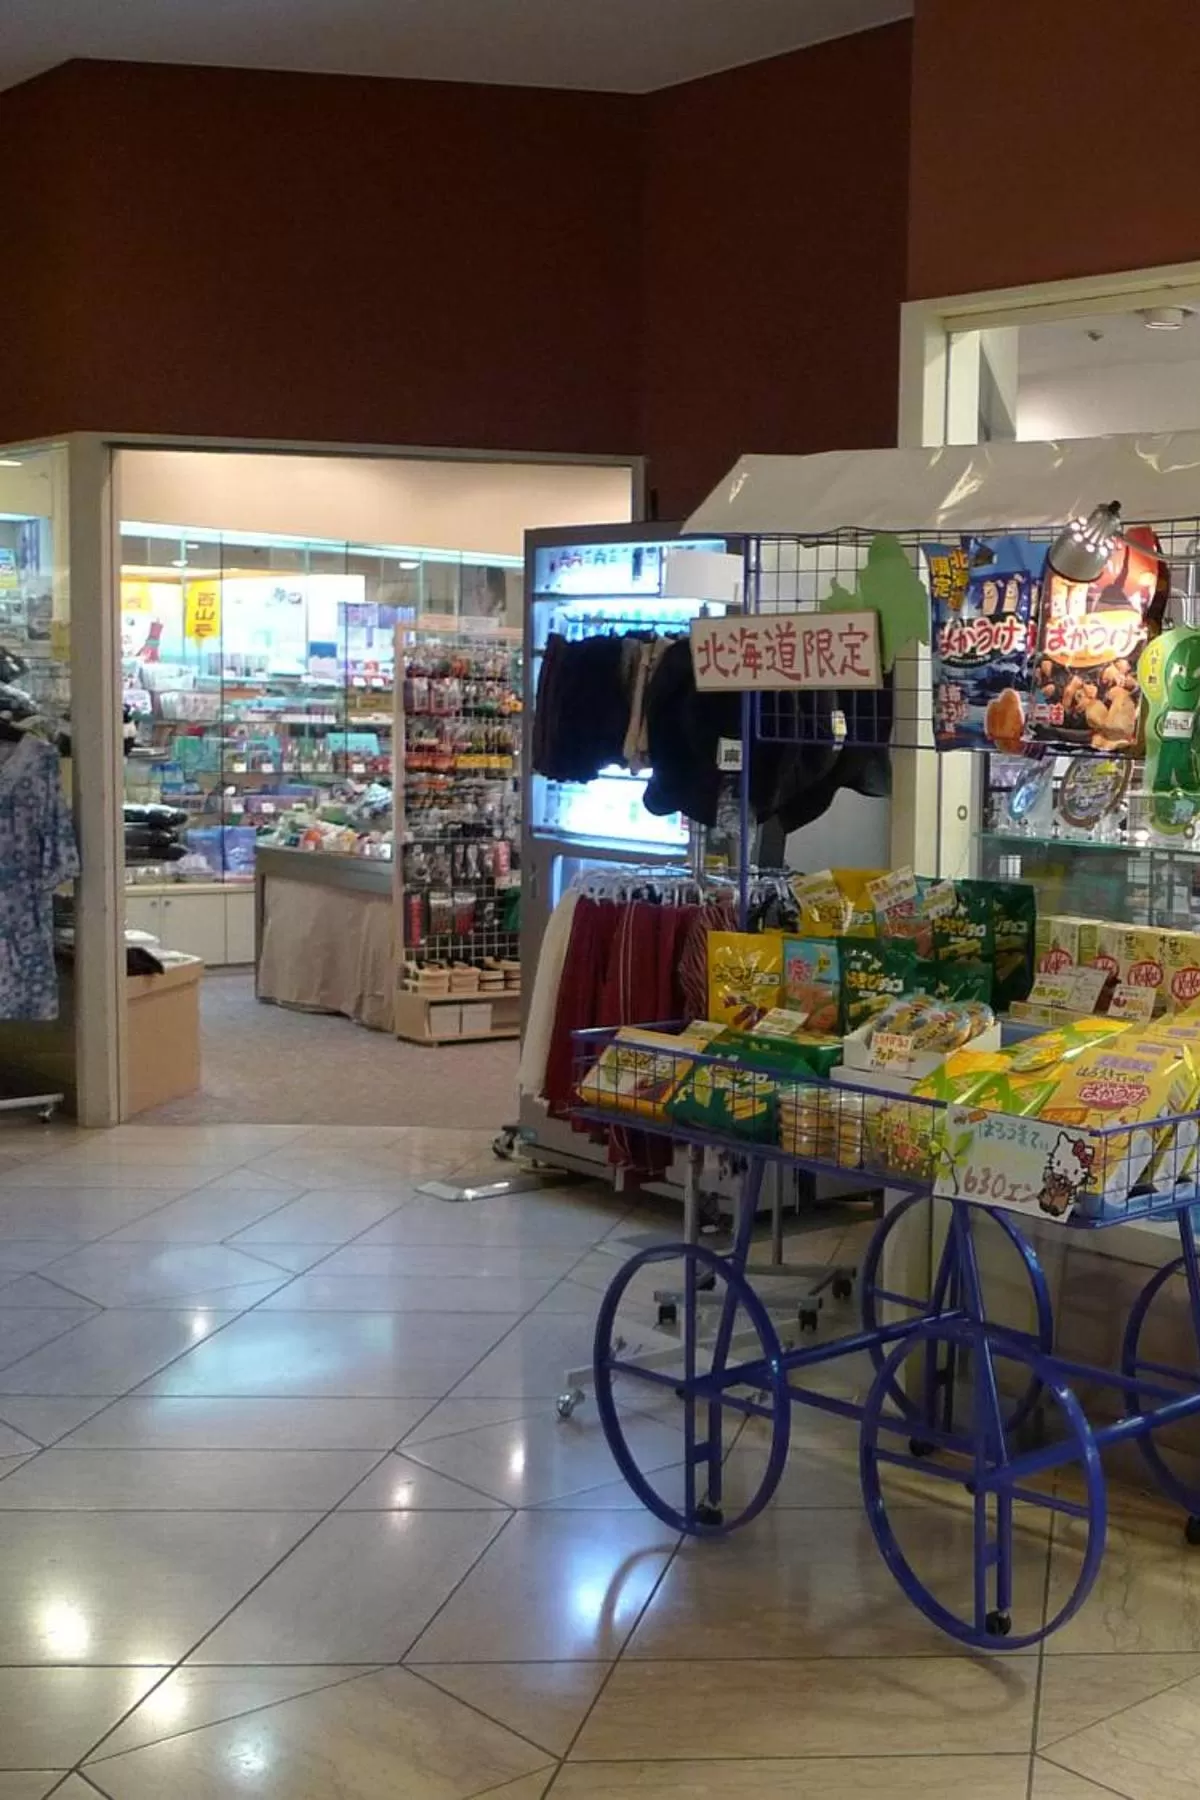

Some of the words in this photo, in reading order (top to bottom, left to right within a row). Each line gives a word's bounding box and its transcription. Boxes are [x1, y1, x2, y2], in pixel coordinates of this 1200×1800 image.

[697, 621, 871, 681] 北海道限定
[1044, 617, 1147, 654] ばかうけ
